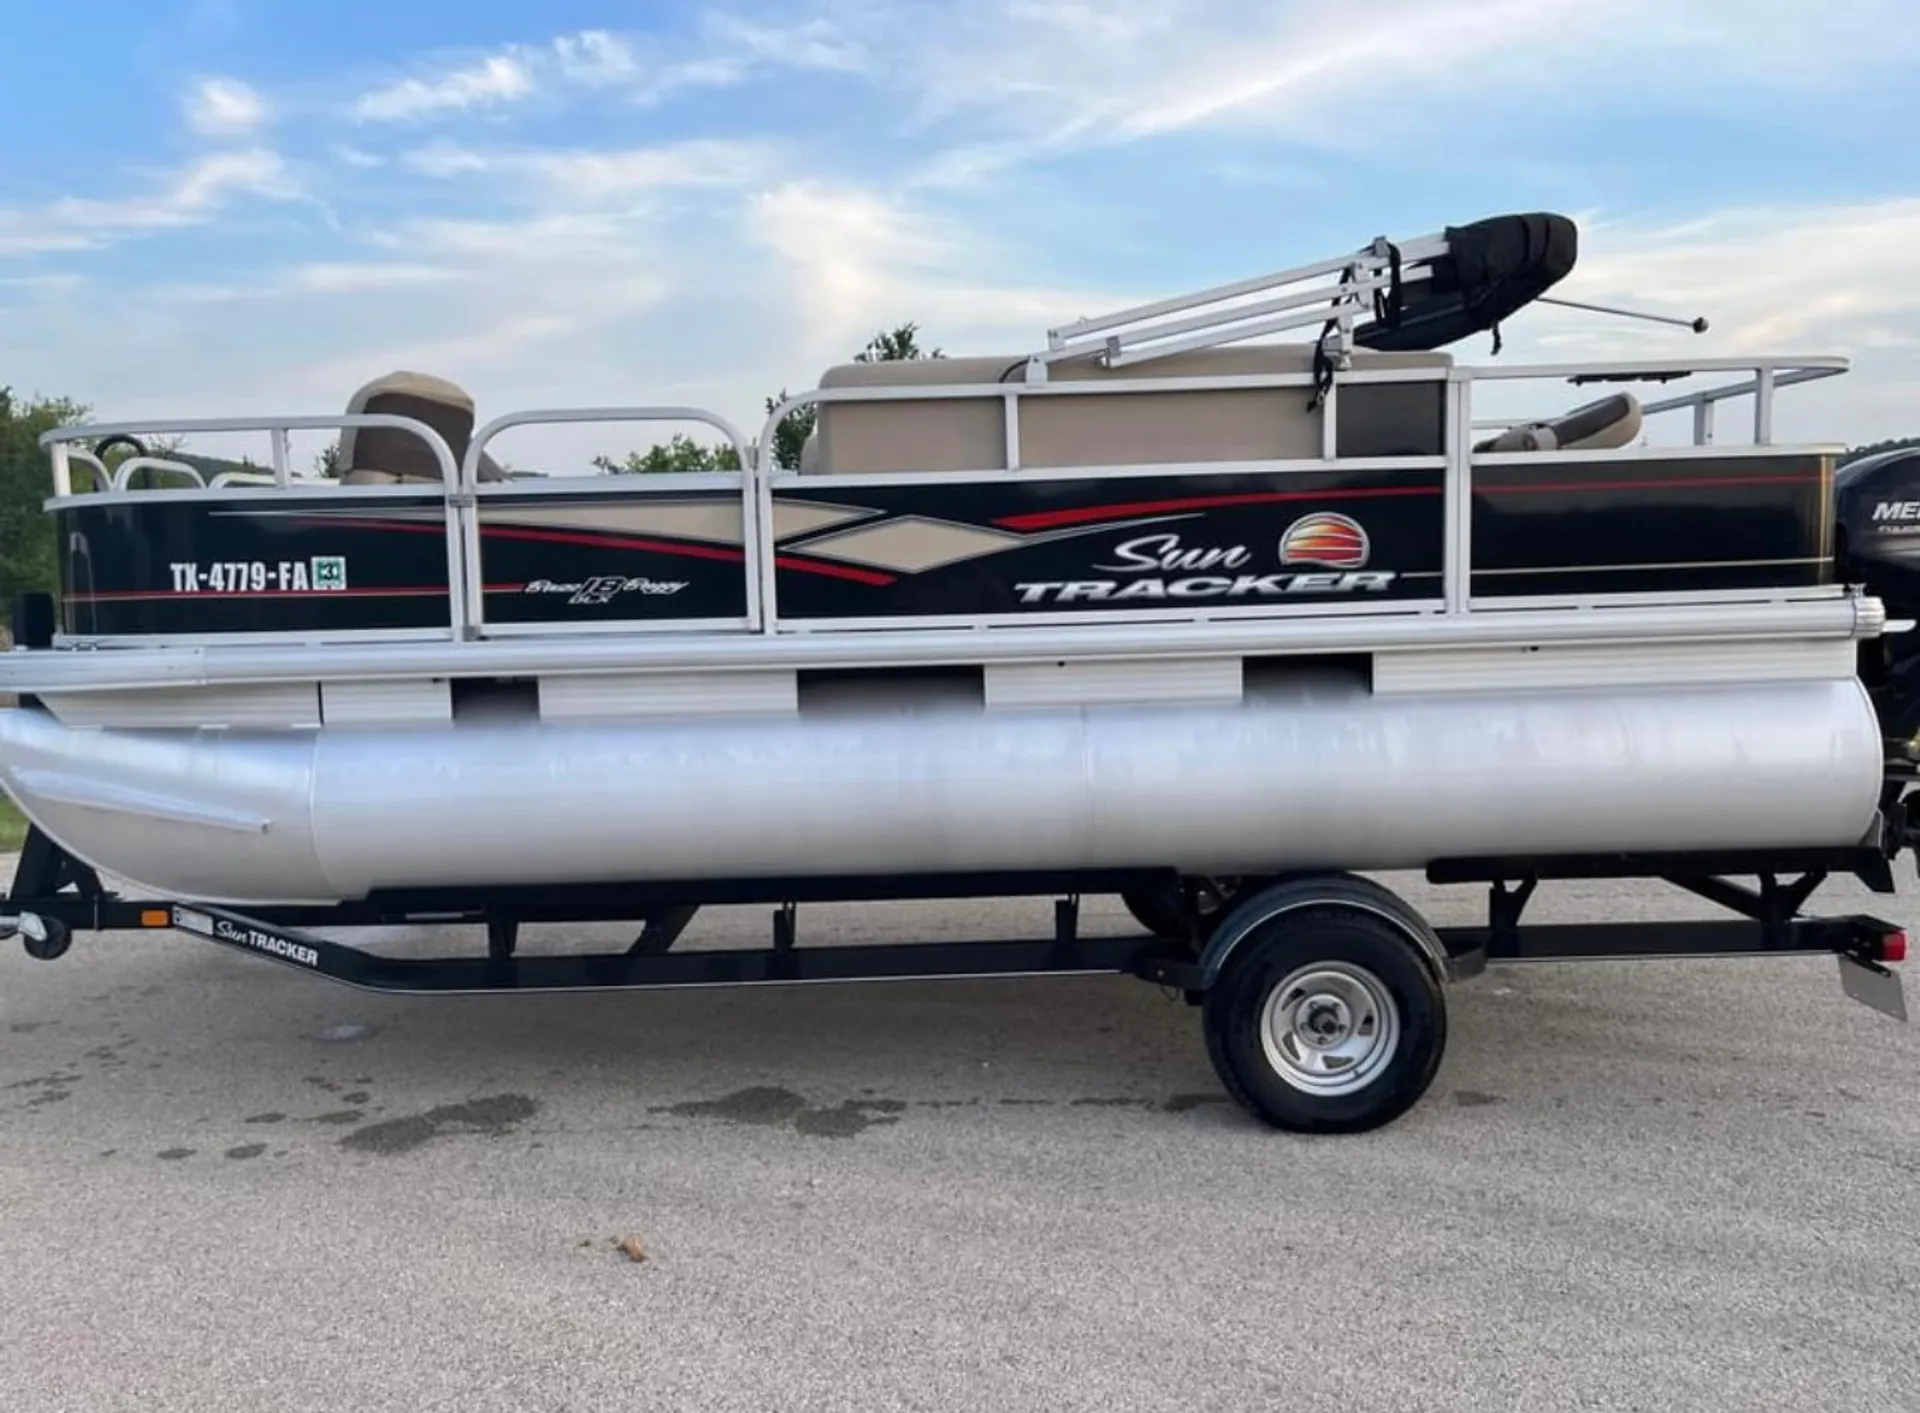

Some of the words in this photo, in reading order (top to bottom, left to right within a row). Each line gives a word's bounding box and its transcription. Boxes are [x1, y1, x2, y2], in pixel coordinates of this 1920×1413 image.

[1872, 501, 1920, 520] ME
[1092, 533, 1251, 572] Sun
[168, 561, 309, 592] TX-4779-FA
[1014, 571, 1396, 602] TRACKER
[217, 920, 247, 943] Sun
[249, 930, 318, 967] TRACKER
